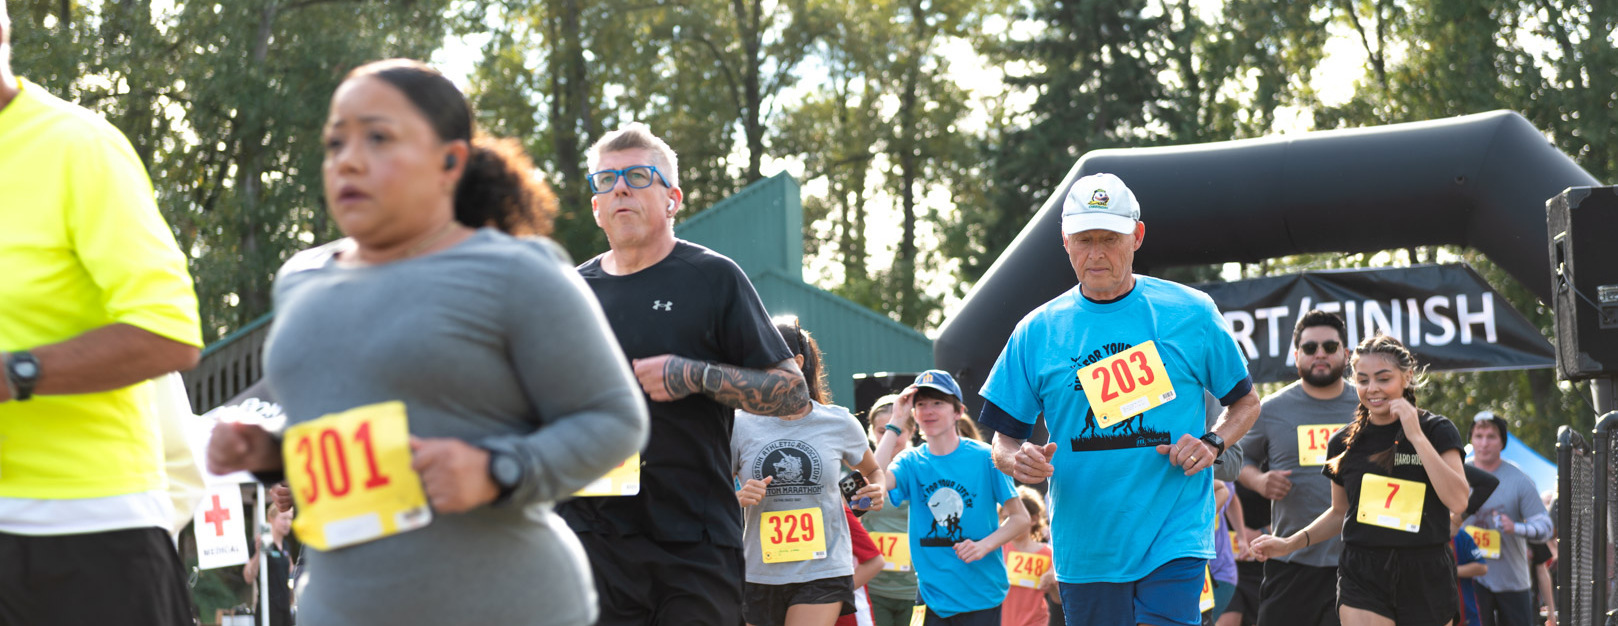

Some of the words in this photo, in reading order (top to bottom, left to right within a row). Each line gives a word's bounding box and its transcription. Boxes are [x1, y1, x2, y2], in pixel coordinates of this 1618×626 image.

[1082, 349, 1103, 367] FOR
[1091, 350, 1155, 403] 203
[1307, 428, 1340, 450] 13
[296, 420, 391, 505] 301
[755, 457, 764, 481] OSTON
[762, 441, 796, 457] ATHLETIC
[796, 442, 820, 480] ASSOCIATION
[1394, 453, 1410, 466] HARD
[783, 486, 821, 494] MARATHON
[925, 482, 938, 494] FOR
[938, 479, 955, 487] YOUR
[955, 484, 969, 498] LIFE
[1384, 482, 1401, 509] 7
[768, 512, 815, 545] 329
[877, 536, 898, 558] 17
[1013, 554, 1044, 577] 248
